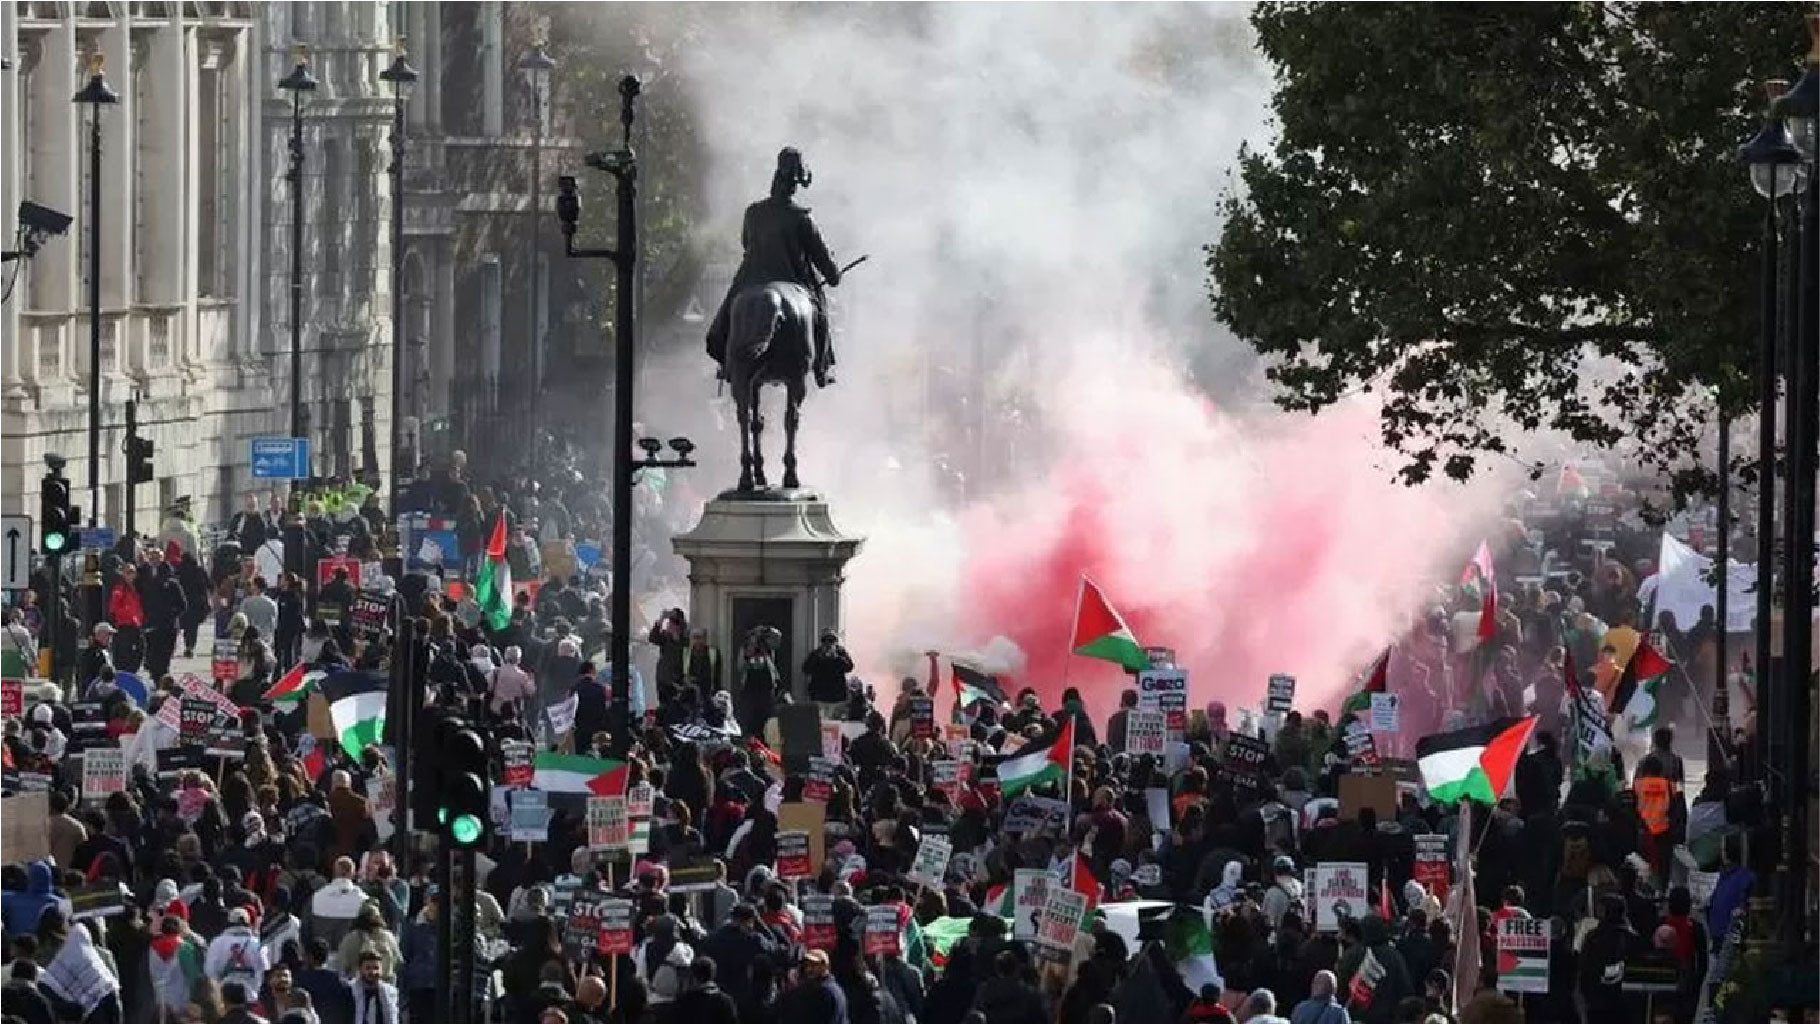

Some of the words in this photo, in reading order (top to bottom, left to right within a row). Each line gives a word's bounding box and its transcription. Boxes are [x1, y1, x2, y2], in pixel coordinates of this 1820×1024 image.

[182, 709, 214, 724] STOP
[1230, 744, 1265, 763] STOP
[1506, 919, 1544, 935] FREE
